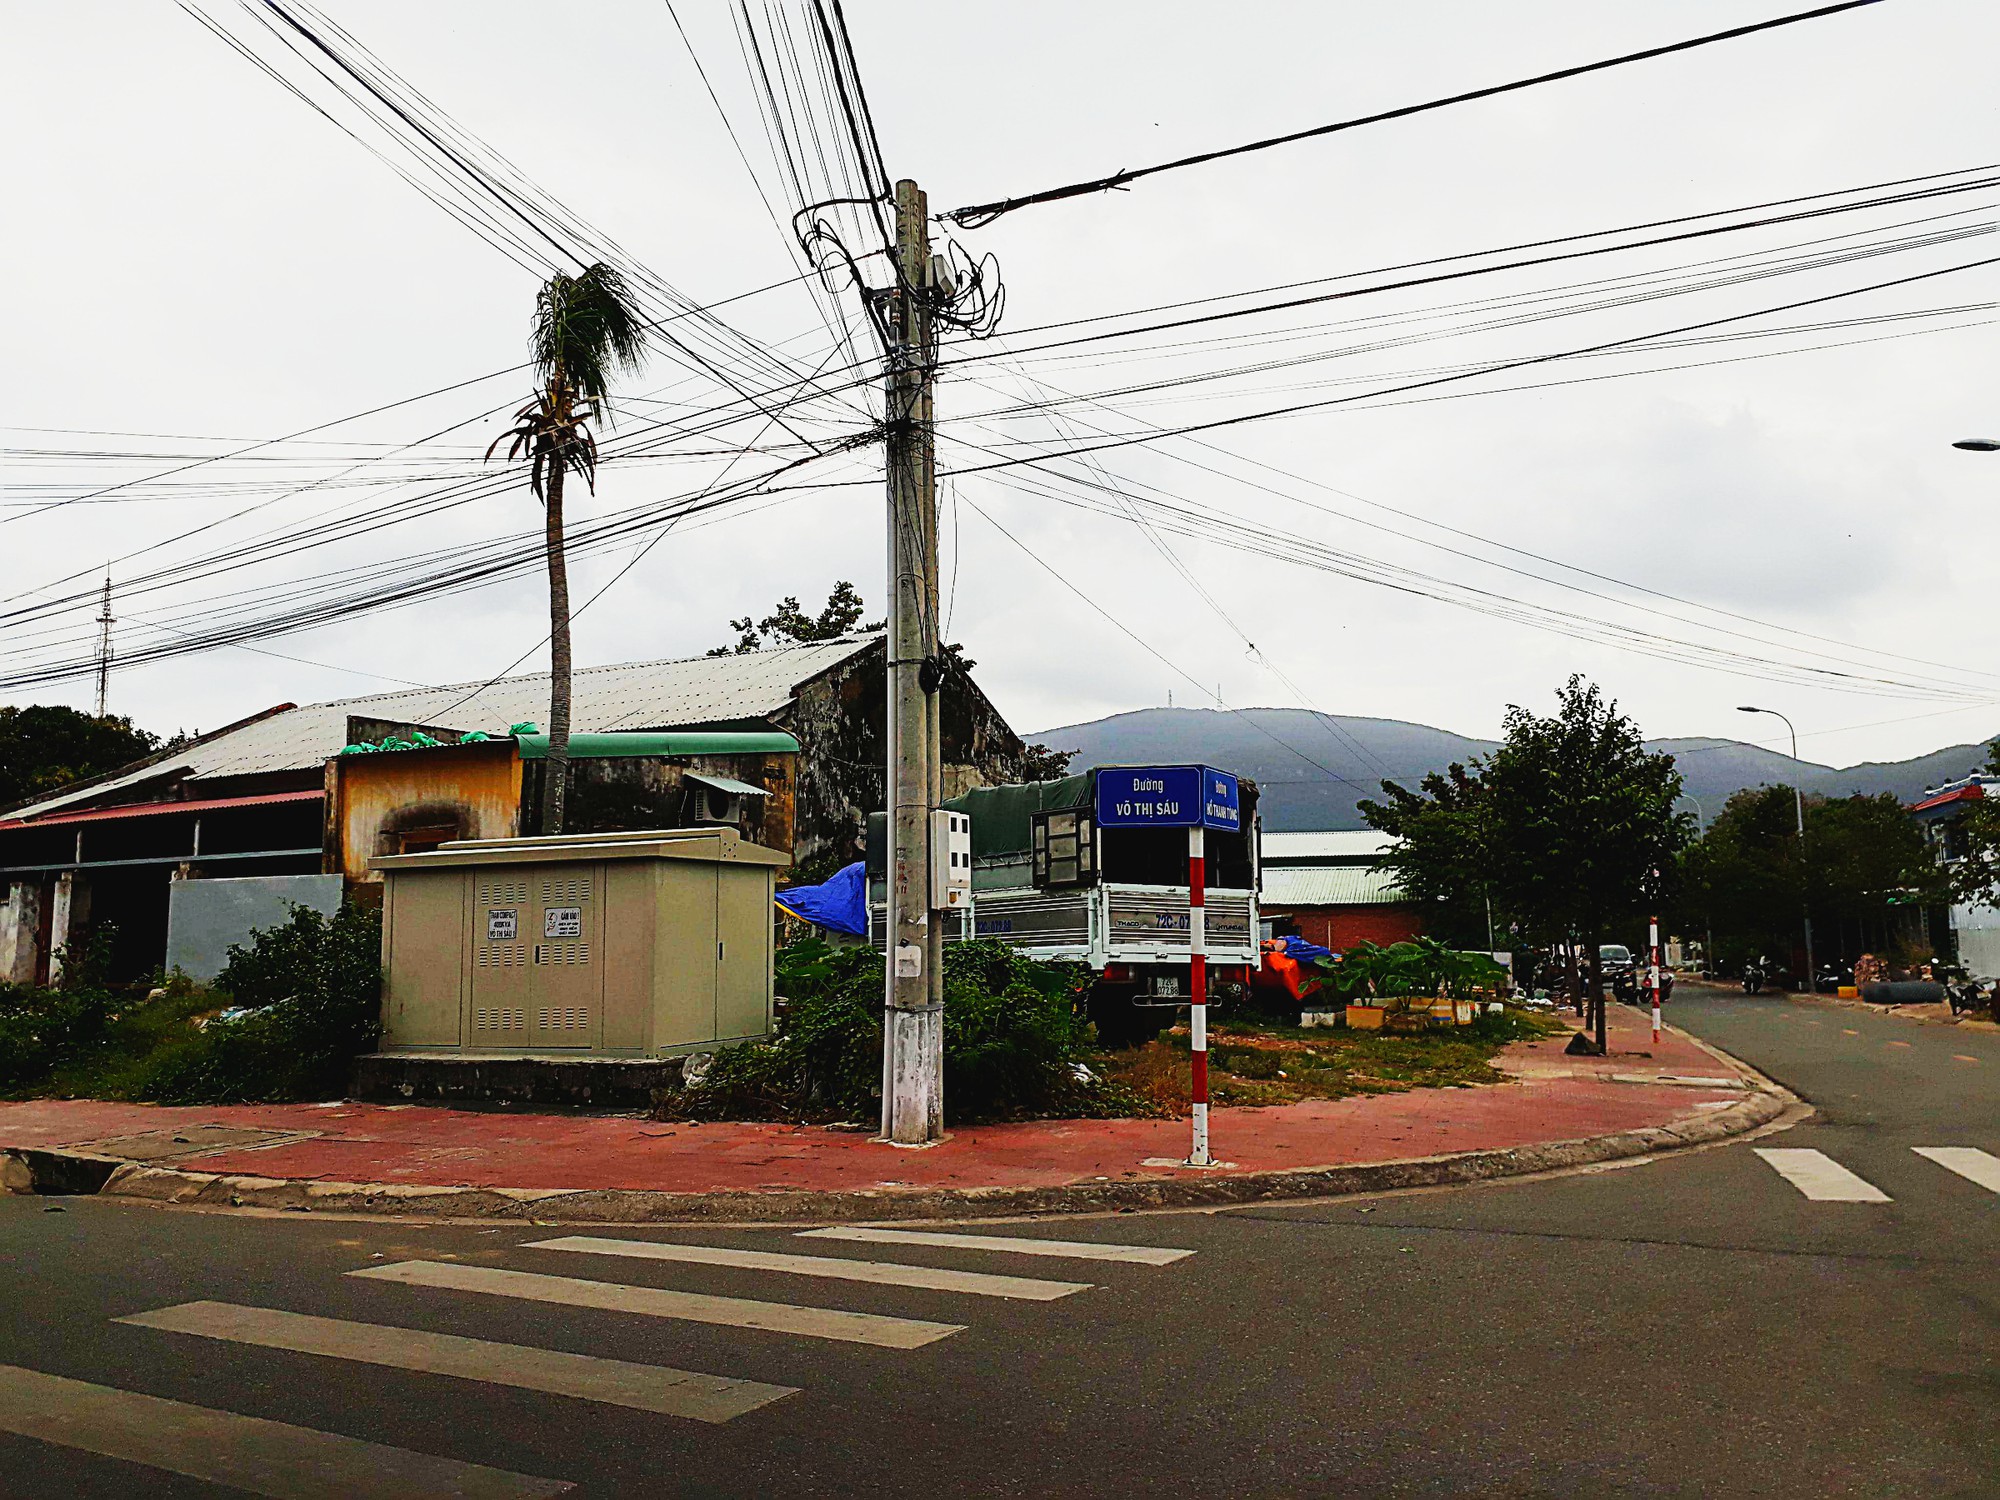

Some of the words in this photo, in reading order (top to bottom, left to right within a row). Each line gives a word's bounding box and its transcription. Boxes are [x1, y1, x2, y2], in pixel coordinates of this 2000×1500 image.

[1133, 778, 1164, 794] Đường
[1116, 800, 1131, 816] VÕ
[1134, 802, 1153, 818] THỊ
[1156, 800, 1179, 815] SÁU
[1116, 920, 1140, 928] THACO
